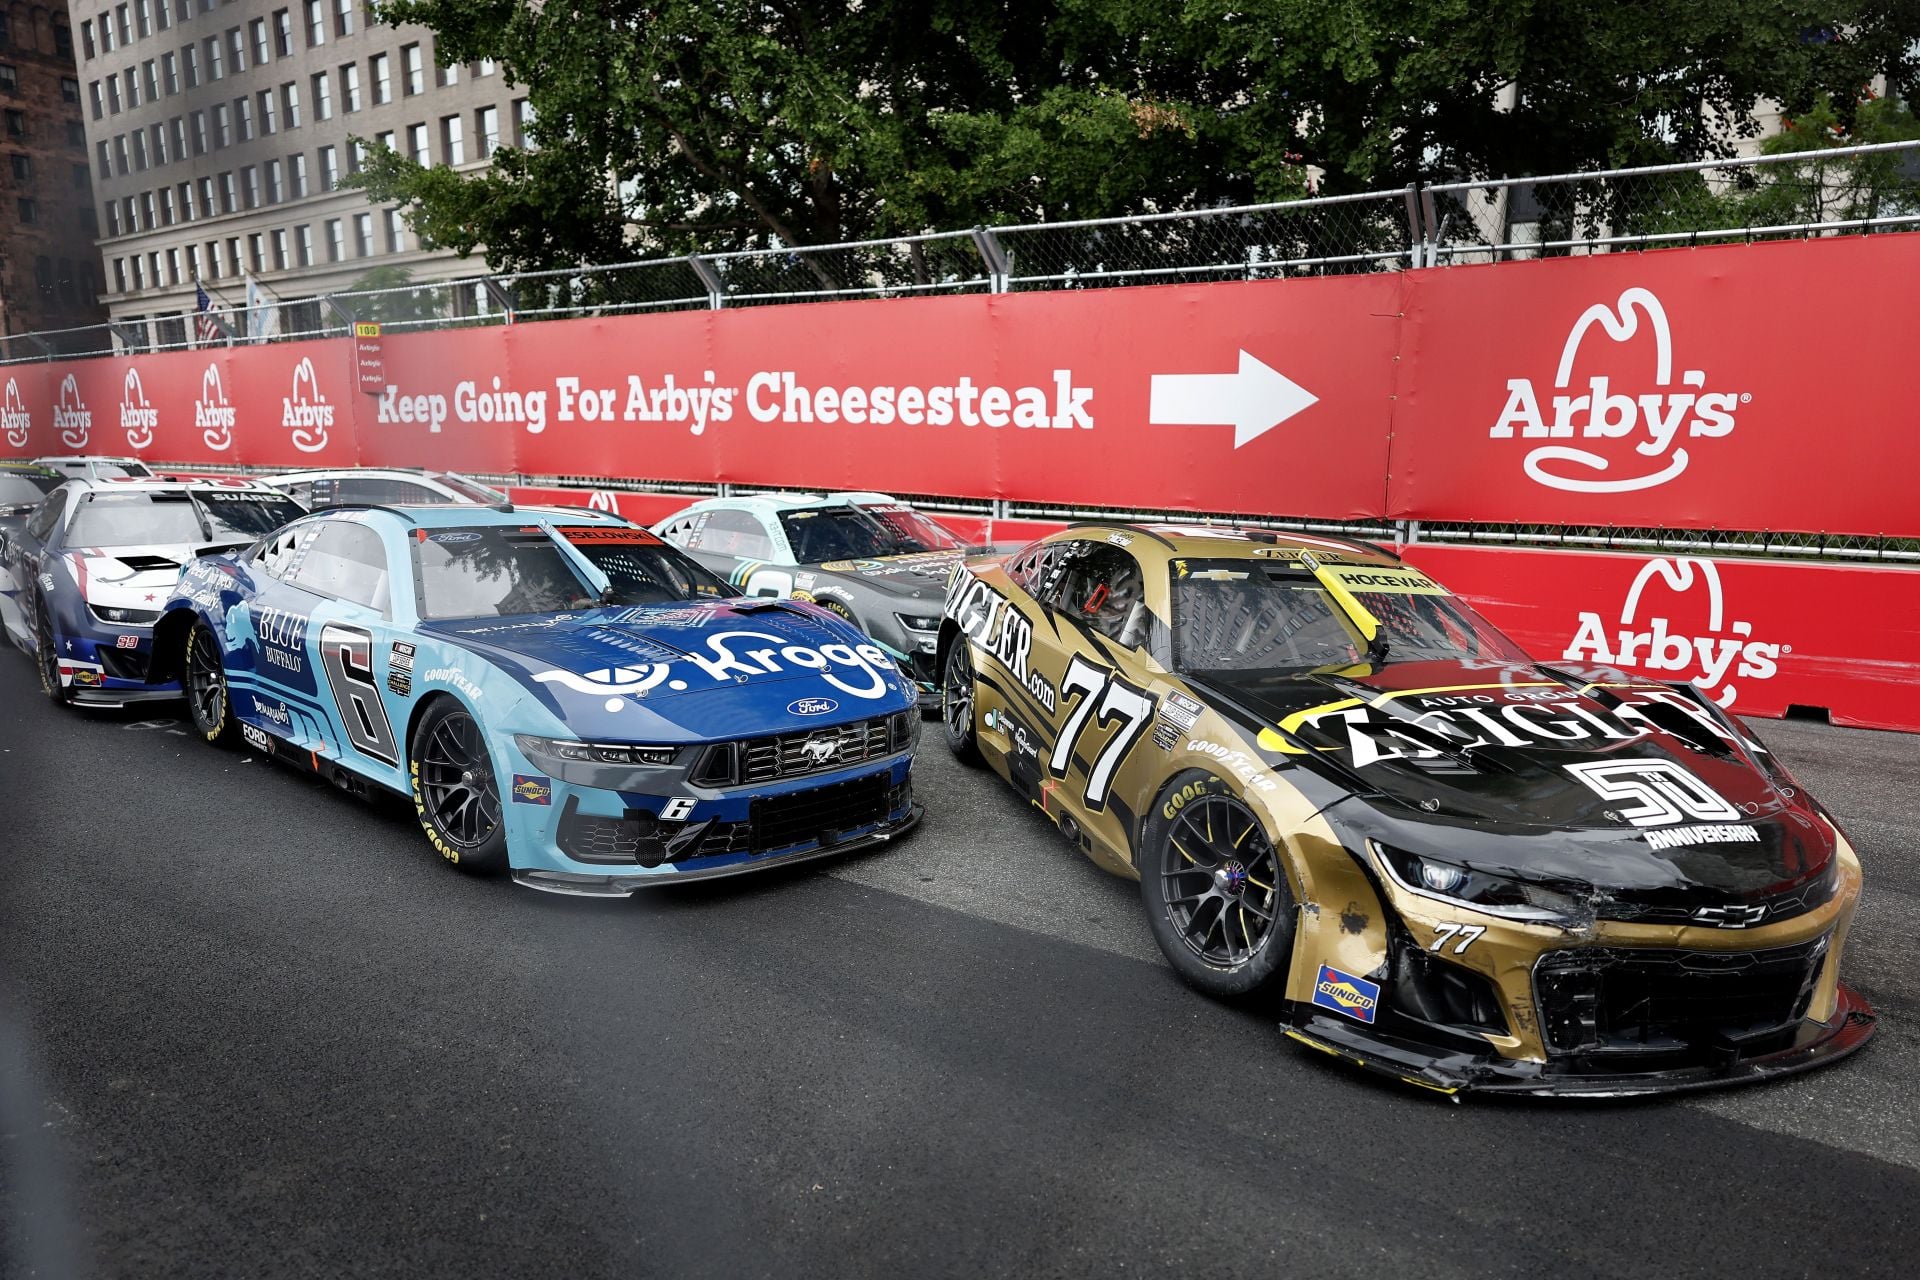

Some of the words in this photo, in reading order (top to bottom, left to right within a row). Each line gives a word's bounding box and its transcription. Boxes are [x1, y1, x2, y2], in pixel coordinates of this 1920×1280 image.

[359, 326, 377, 336] 100
[120, 399, 158, 434] Arby's
[195, 397, 236, 434] Arby's
[281, 394, 334, 436] Arby's
[377, 384, 447, 433] Keep
[454, 376, 547, 434] Going
[556, 376, 618, 422] For
[623, 370, 733, 436] Arby's
[746, 369, 1094, 430] Cheesesteak
[1489, 370, 1739, 456] Arby's
[1, 403, 31, 434] Arby's
[53, 401, 92, 434] Arby's
[212, 492, 288, 503] SUÁREZ
[436, 532, 473, 542] Ford
[563, 531, 653, 541] ESELOWSKI
[176, 579, 196, 597] like
[811, 585, 855, 601] GOODYEAR
[1339, 572, 1438, 590] HOCEVAR
[827, 602, 850, 620] EAGLE
[116, 634, 140, 650] 99
[259, 606, 308, 652] BLUE
[265, 645, 302, 672] BUFFALO
[685, 630, 895, 700] Kroge
[1562, 611, 1781, 691] Arby's
[74, 672, 99, 681] SUNOCO
[424, 667, 484, 700] GOODYEAR
[320, 619, 400, 770] 6
[797, 700, 831, 714] Ford
[1420, 694, 1496, 708] AUTO
[1503, 690, 1579, 702] GROU
[242, 723, 267, 746] FORD
[1050, 655, 1156, 808] 77
[1186, 739, 1278, 792] GOODYEAR
[1636, 771, 1669, 783] TH
[514, 784, 550, 796] SUNOCO
[1562, 757, 1741, 827] 50
[410, 759, 460, 864] GOODYEAR
[658, 797, 699, 821] 6
[1643, 825, 1761, 851] ANNIVERSARY
[1431, 922, 1488, 956] 77
[1318, 980, 1374, 1010] SUNOCO
